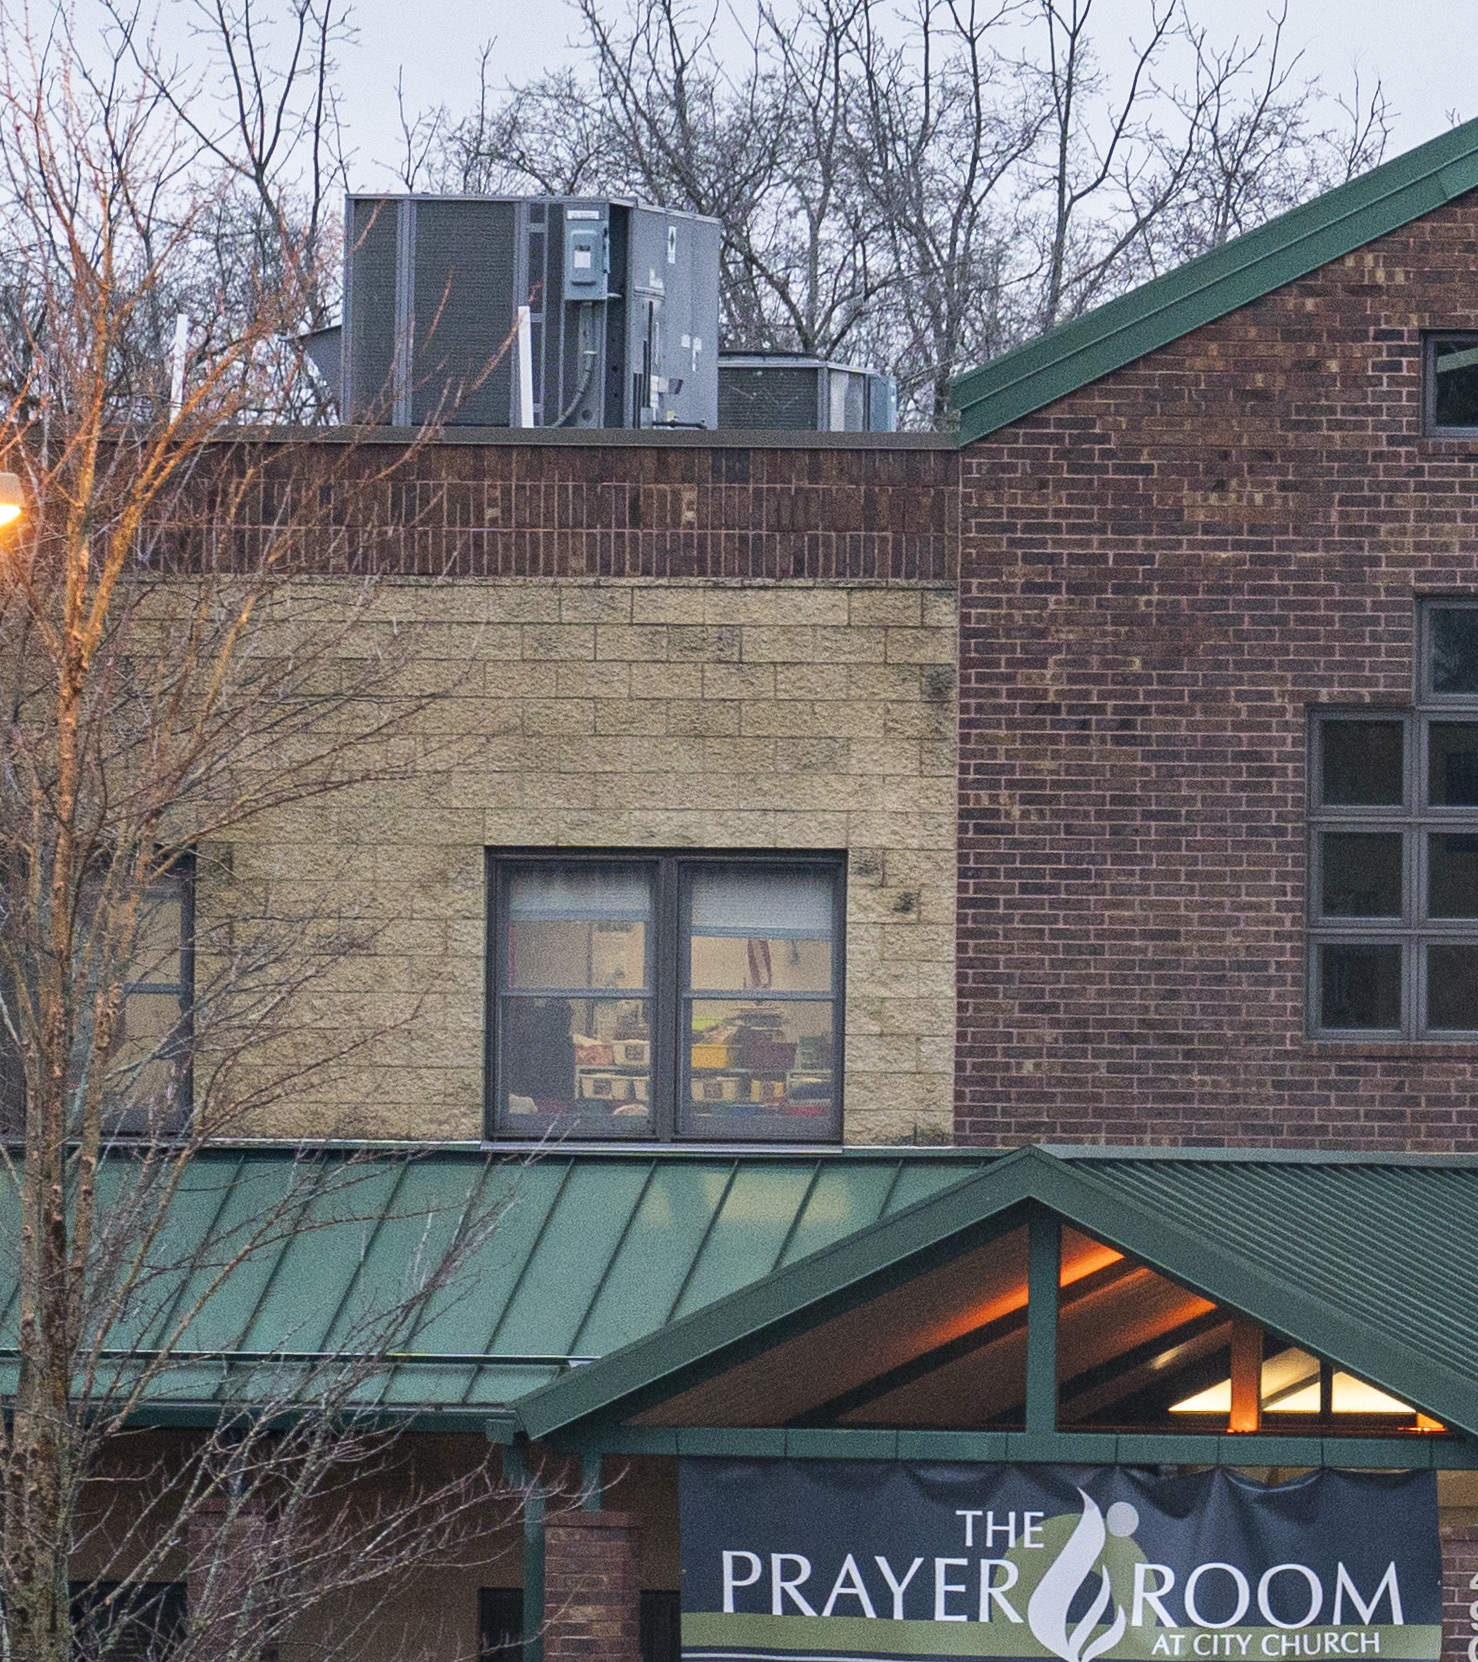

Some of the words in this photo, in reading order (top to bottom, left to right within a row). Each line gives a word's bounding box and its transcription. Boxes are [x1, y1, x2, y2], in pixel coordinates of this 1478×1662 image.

[956, 1510, 1045, 1549] THE
[722, 1551, 1025, 1625] PRAYER
[1131, 1562, 1405, 1630] ROOM
[1151, 1633, 1187, 1657] AT
[1192, 1633, 1253, 1656] CITY
[1260, 1631, 1381, 1656] CHURCH
